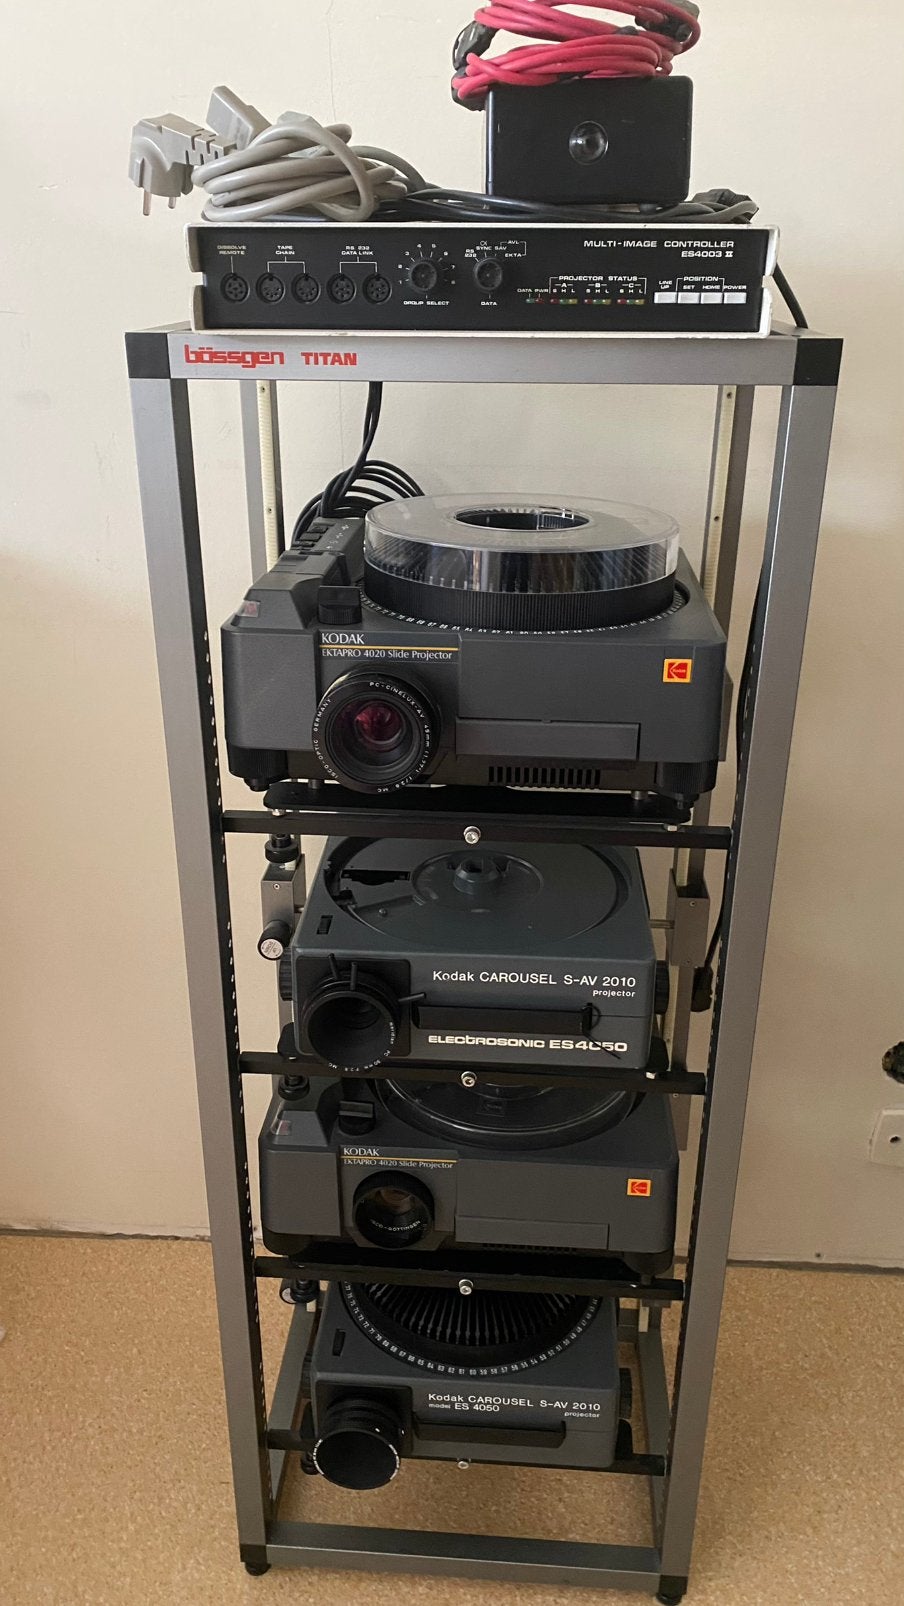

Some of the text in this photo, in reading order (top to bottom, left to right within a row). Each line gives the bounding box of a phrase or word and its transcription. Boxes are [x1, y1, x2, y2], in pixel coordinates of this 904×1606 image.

[663, 240, 735, 248] CONTROLLER
[681, 250, 723, 258] ES4003
[184, 344, 358, 368] bössgen TITAN
[321, 632, 366, 645] KODAK
[321, 648, 453, 661] EKTAPRO 4020 Slide Projector
[432, 970, 637, 990] Kodak CAROUSEL S-AV 2010
[592, 990, 637, 999] projector
[343, 1146, 380, 1157] KODAK
[379, 1159, 399, 1167] 4020
[399, 1160, 419, 1168] Slide
[419, 1161, 455, 1170] Projector
[428, 1393, 601, 1411] Kodak CAROUSEL S-AV 2010
[454, 1402, 470, 1411] ES
[472, 1403, 500, 1412] 4050
[563, 1411, 600, 1419] projector
